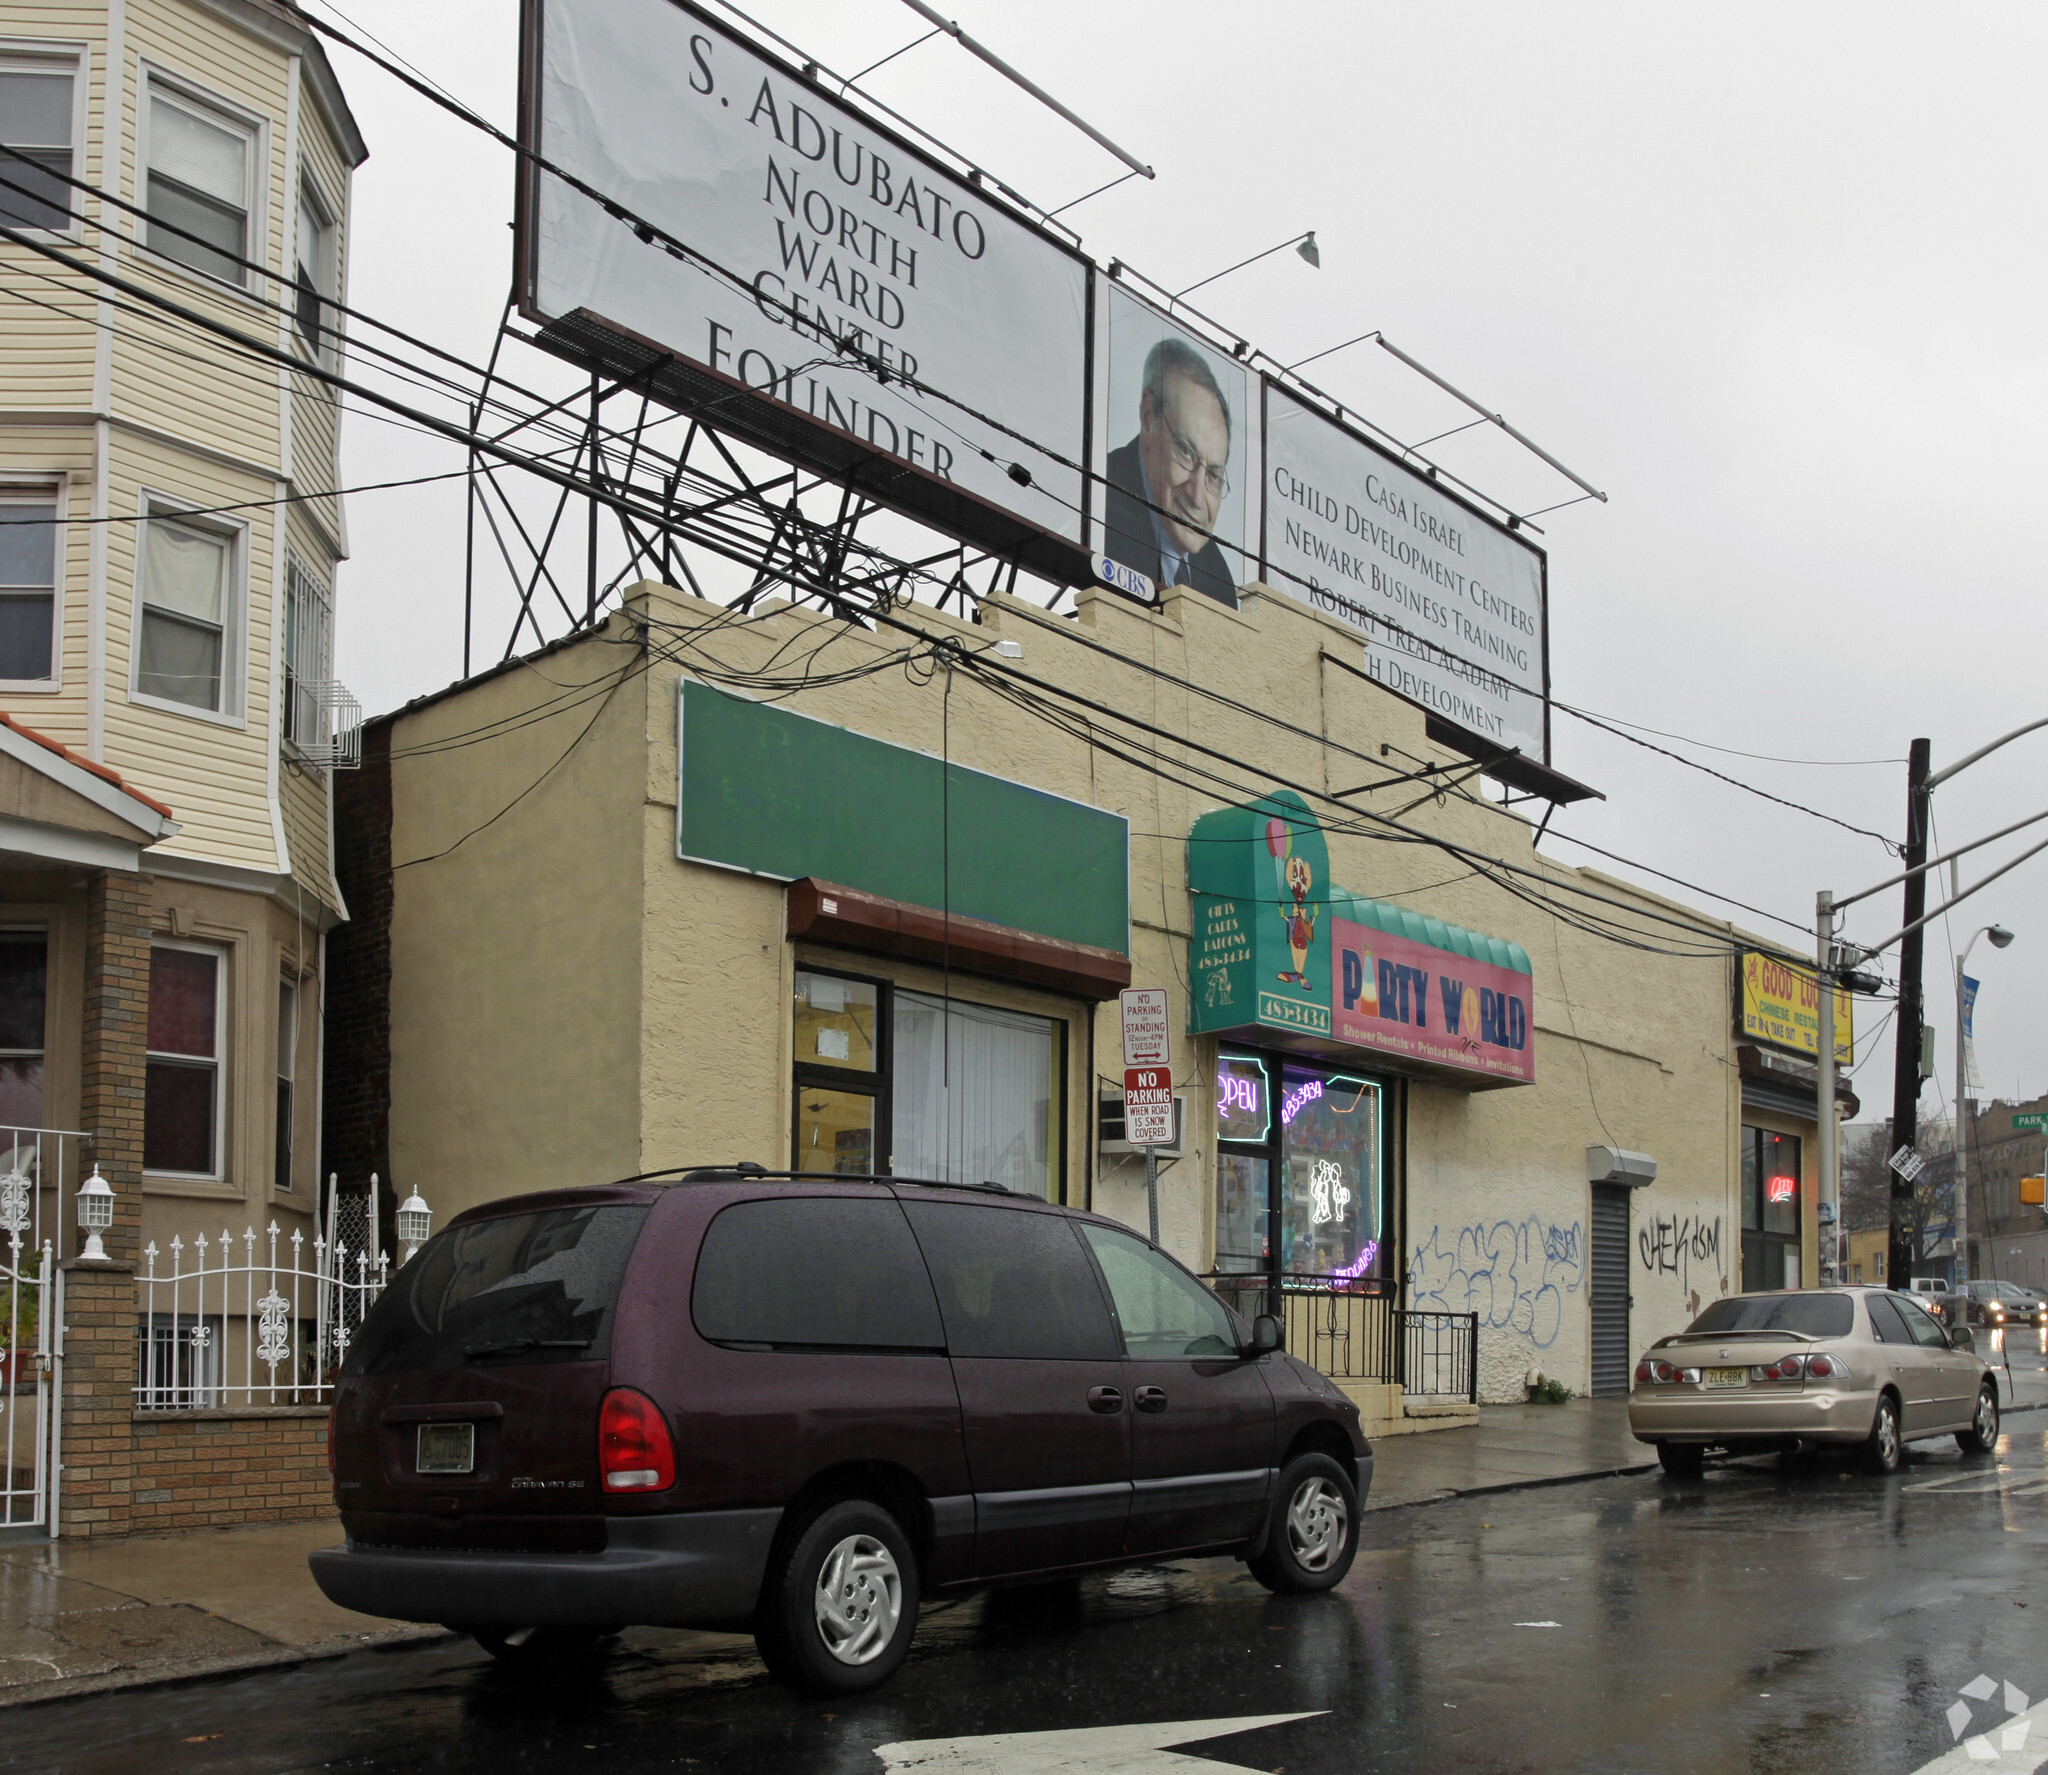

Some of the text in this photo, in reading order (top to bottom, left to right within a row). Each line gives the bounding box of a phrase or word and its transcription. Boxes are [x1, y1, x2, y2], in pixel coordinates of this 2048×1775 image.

[688, 34, 985, 260] S. ADUBATO
[762, 155, 918, 289] NORTH
[774, 216, 904, 330] WARD
[752, 270, 925, 399] CENTER
[704, 317, 954, 483] FOUNDER
[1366, 475, 1465, 556] CASA ISRAEL
[1274, 467, 1534, 637] CHILD DEVELOPMENT CENTERS
[1117, 566, 1146, 597] CBS
[1285, 517, 1528, 672] NEWARK BUSINESS TRAINING
[1309, 575, 1512, 702] ROBERT TREAT ACADEMY
[1389, 660, 1504, 738] DEVELOPMENT
[1208, 902, 1235, 919] GIFTS
[1207, 918, 1239, 935] CARDS
[1204, 932, 1247, 952] BALOONS
[1198, 948, 1251, 970] 485-3434
[1762, 960, 1793, 1001] GOOD
[1127, 1005, 1162, 1016] PARKING
[1137, 994, 1151, 1004] NO
[1759, 1000, 1790, 1022] CHINESE
[1264, 999, 1326, 1028] 485-3434
[1125, 1022, 1166, 1033] STANDING
[1747, 1014, 1756, 1029] EAT
[1771, 1021, 1784, 1038] TAKE
[1785, 1027, 1796, 1042] OUT
[1131, 1042, 1162, 1051] TUESDAY
[1343, 1023, 1524, 1076] Shower Rentals Printed Ribbons Invitations
[1137, 1072, 1157, 1088] NO
[1126, 1088, 1171, 1106] PARKING
[1129, 1104, 1170, 1116] WHEN ROAD
[1134, 1116, 1165, 1128] IS SNOW
[2018, 1116, 2042, 1126] PARK
[1135, 1127, 1167, 1139] COVERED
